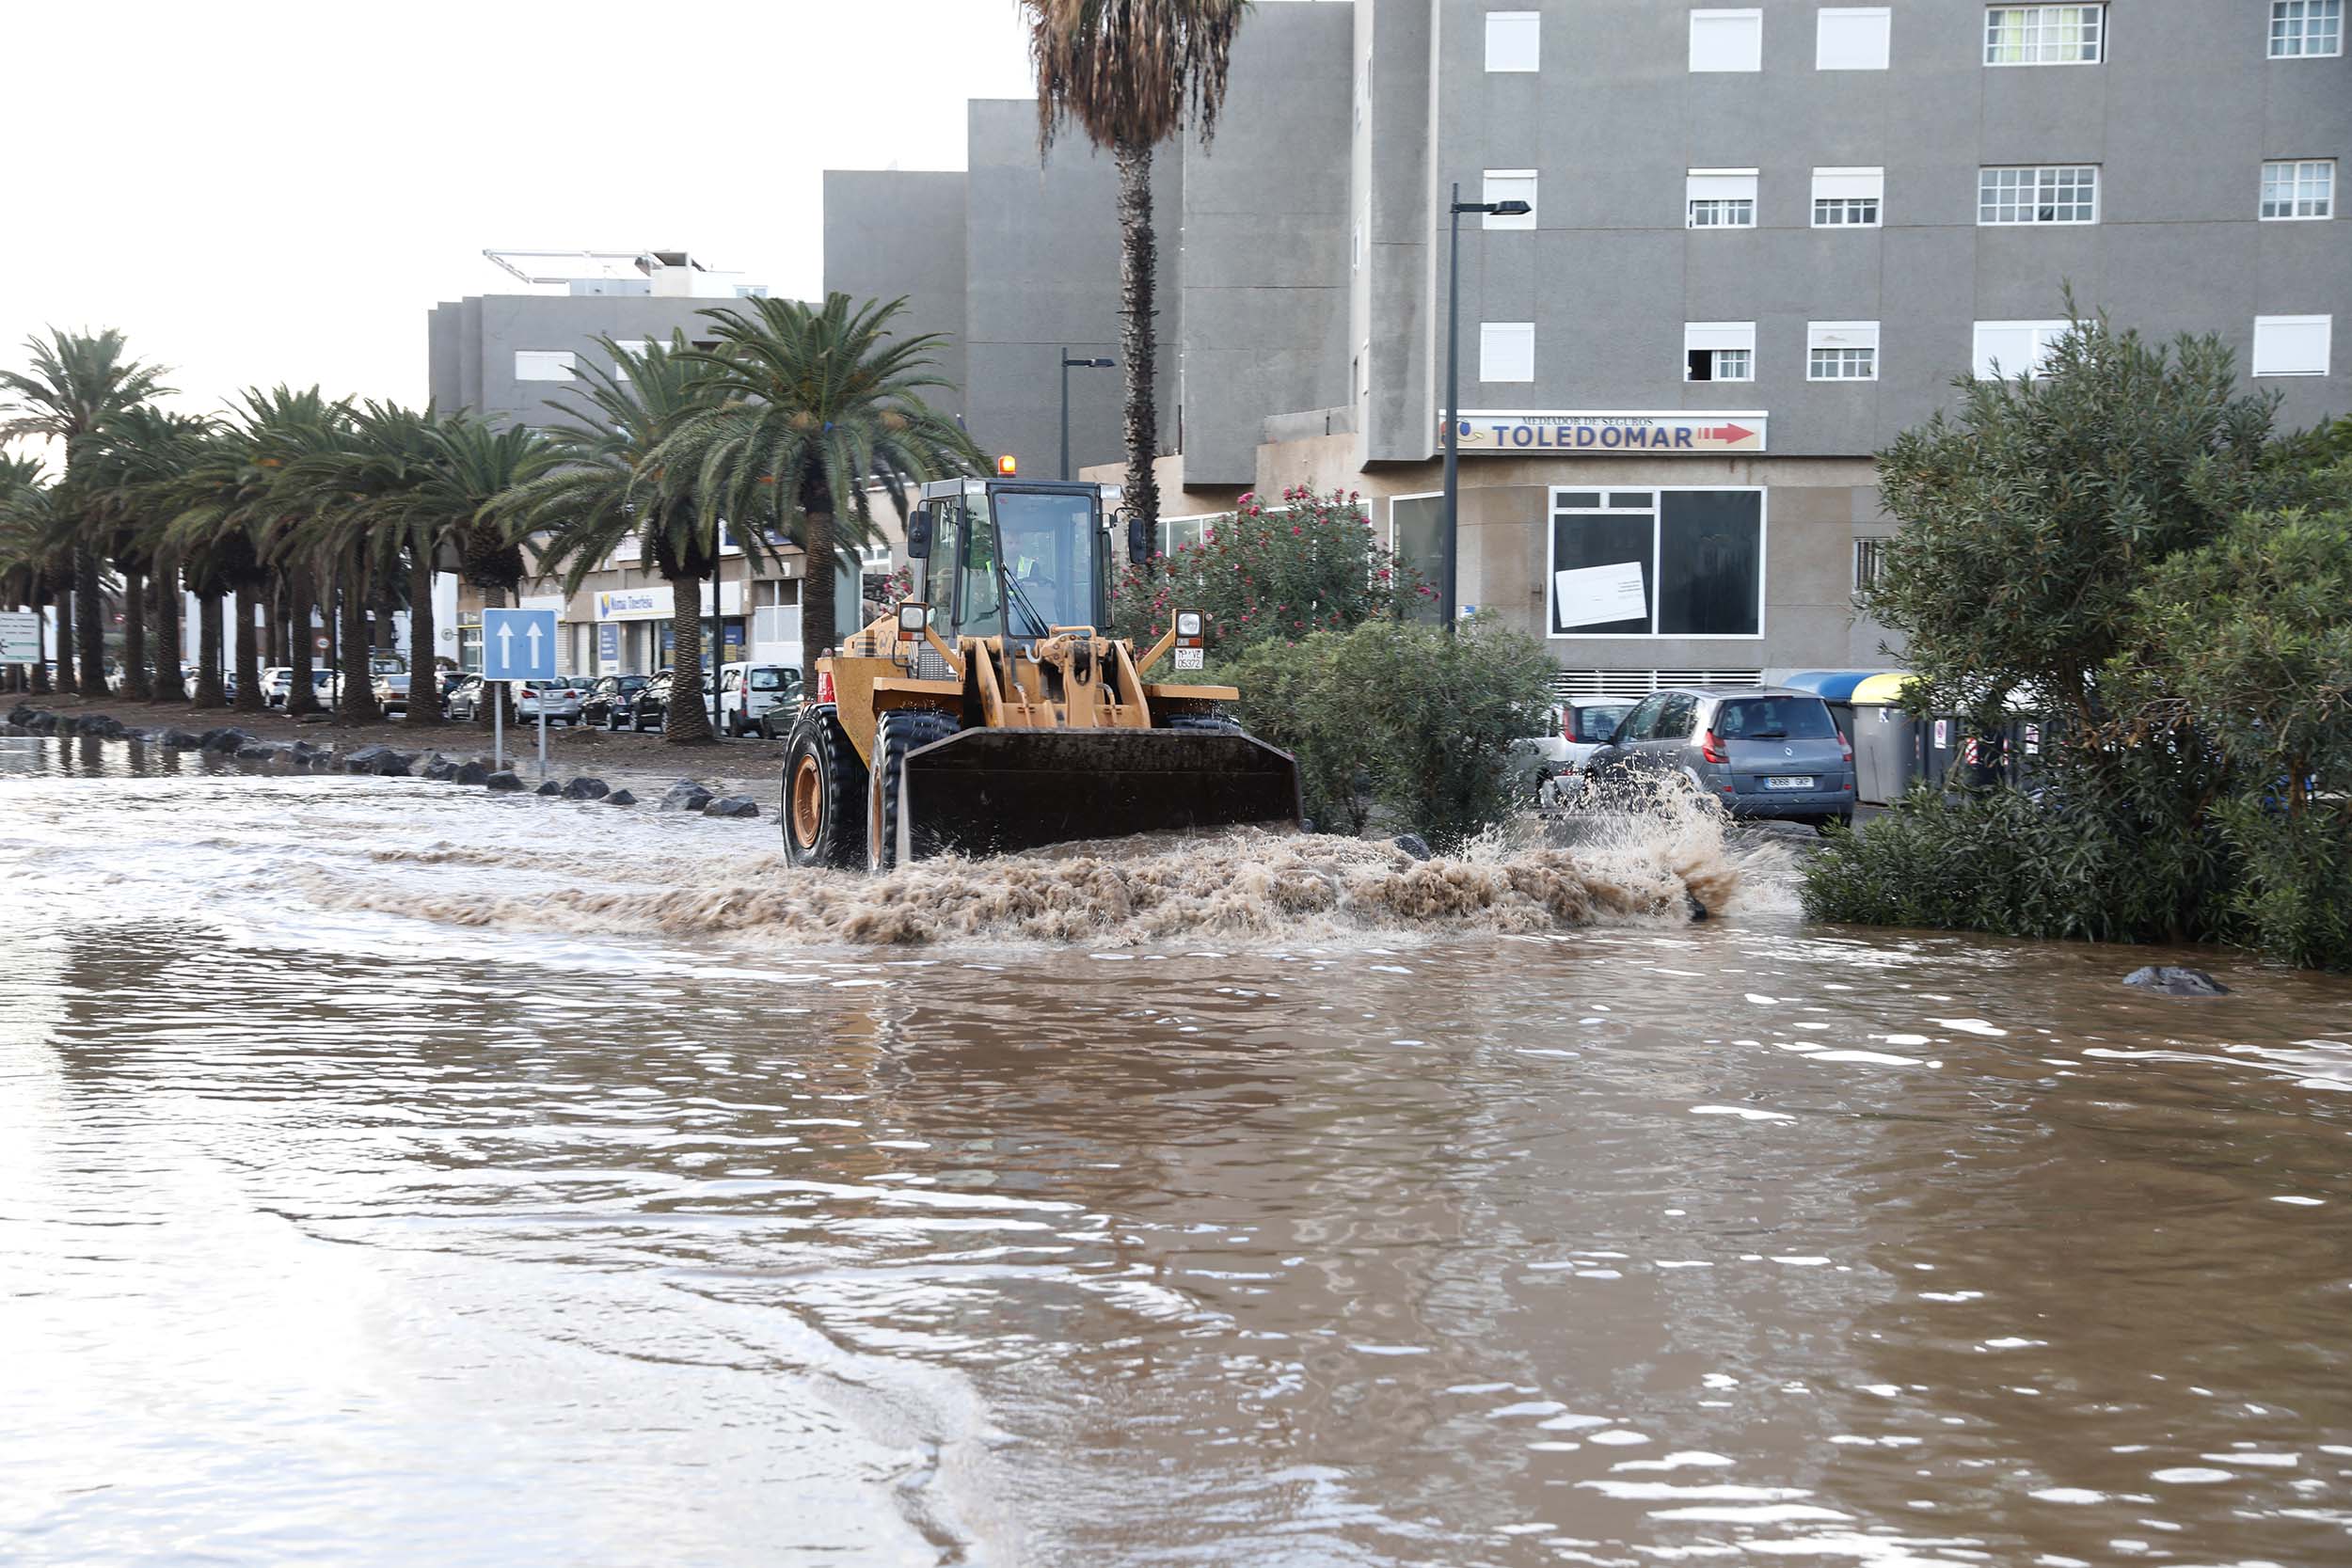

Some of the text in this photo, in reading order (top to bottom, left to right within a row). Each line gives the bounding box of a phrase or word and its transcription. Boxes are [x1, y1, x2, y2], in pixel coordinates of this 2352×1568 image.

[1522, 417, 1654, 427] MEDIADOR DE SEGUROS
[1492, 425, 1693, 448] TOLEDOMAR
